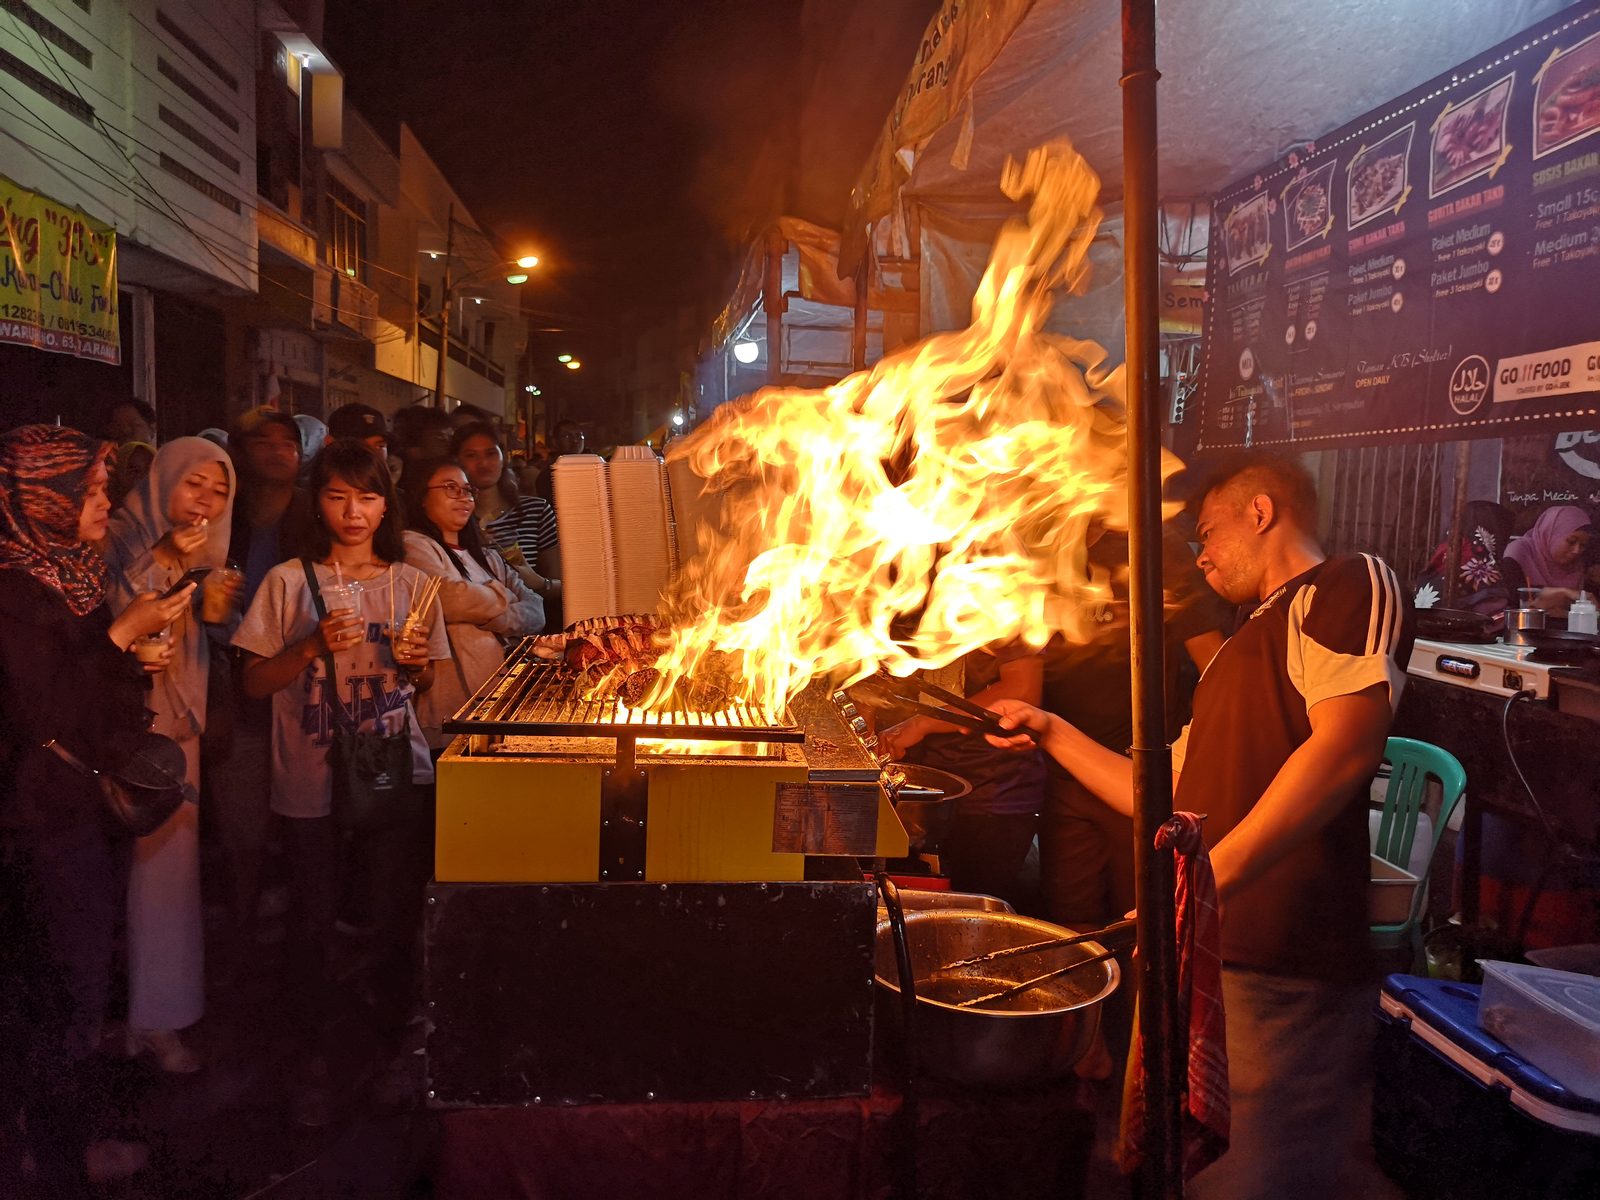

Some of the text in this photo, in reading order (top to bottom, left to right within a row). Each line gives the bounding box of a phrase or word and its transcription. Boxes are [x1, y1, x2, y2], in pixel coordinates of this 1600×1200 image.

[1537, 194, 1572, 218] Small
[1432, 223, 1490, 251] Paket Medium
[1534, 231, 1587, 256] Medium
[1431, 260, 1489, 287] Paket Jumbo
[1355, 374, 1390, 388] OPEN DAILY
[1454, 393, 1479, 403] HALAL
[1507, 491, 1539, 506] Tanpa
[1543, 489, 1578, 502] Mecin
